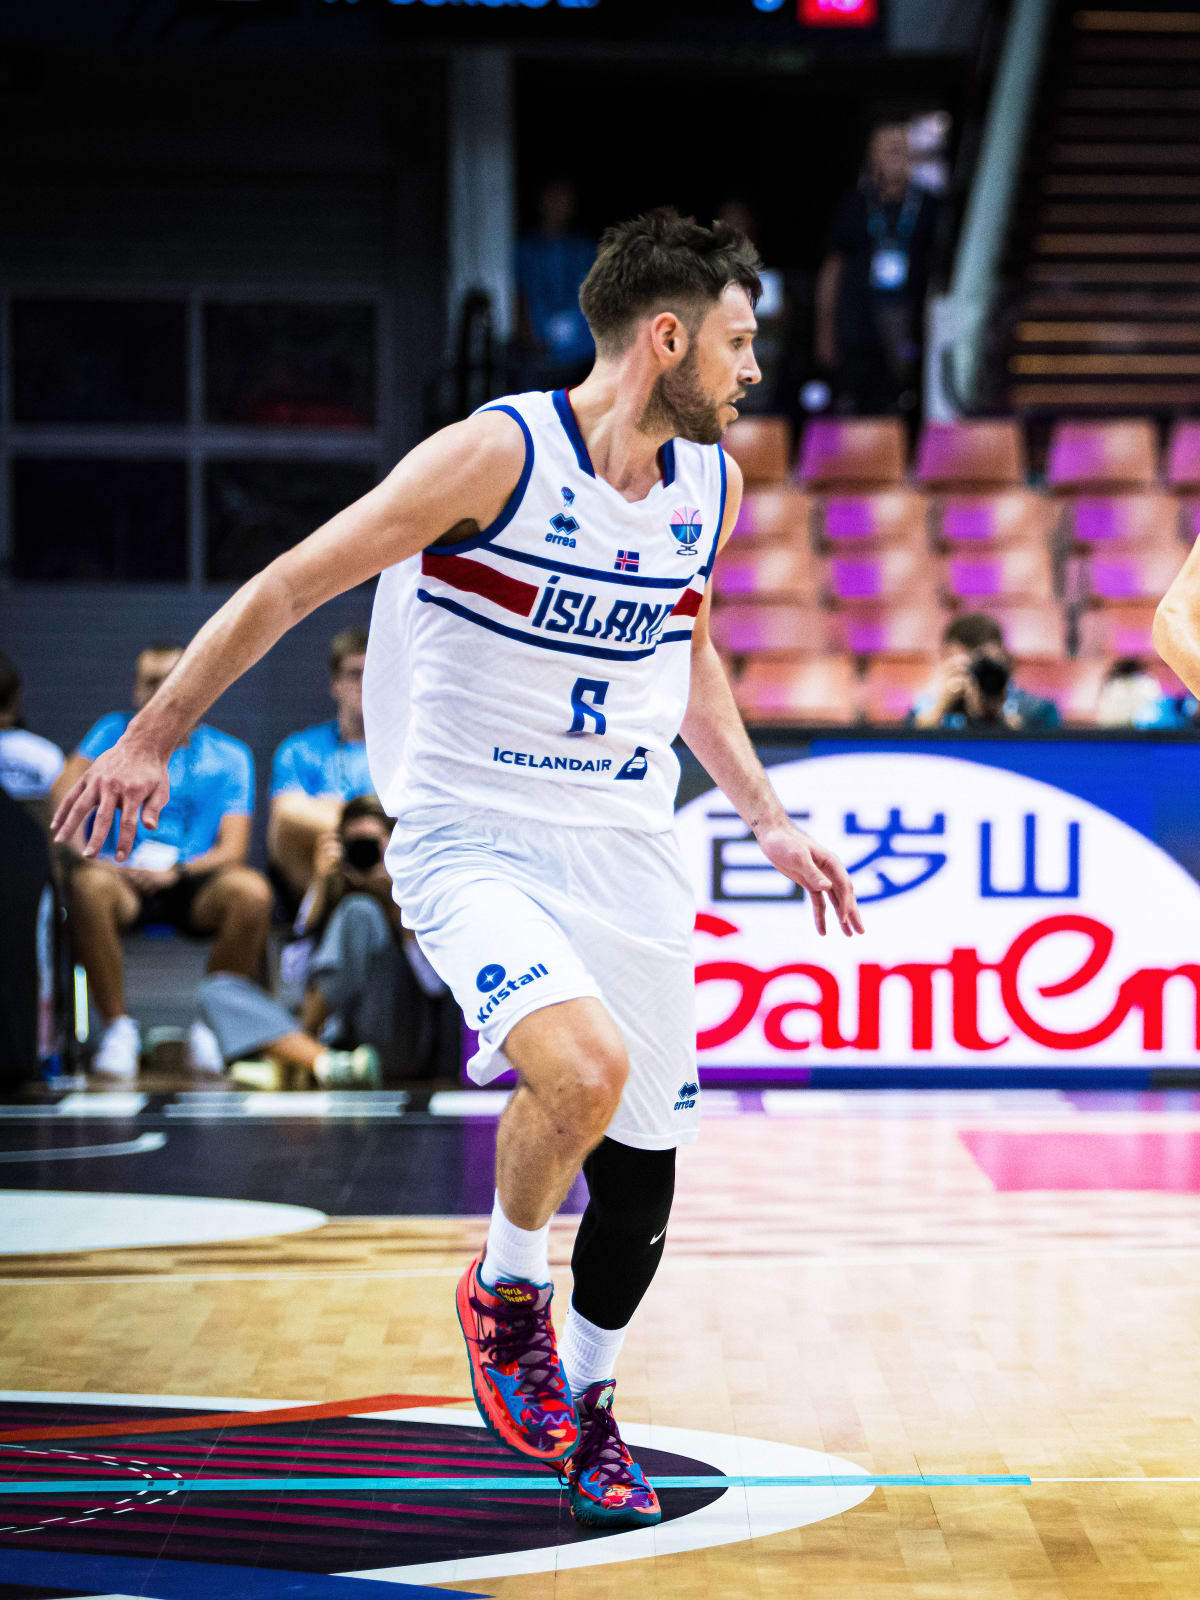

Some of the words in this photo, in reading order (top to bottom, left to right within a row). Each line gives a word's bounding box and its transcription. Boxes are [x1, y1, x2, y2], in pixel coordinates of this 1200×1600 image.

[545, 532, 577, 548] errea
[493, 747, 612, 772] ICELANDAIR
[706, 808, 1081, 904] 百岁山
[476, 963, 550, 1024] Kristall
[674, 1099, 696, 1111] errea
